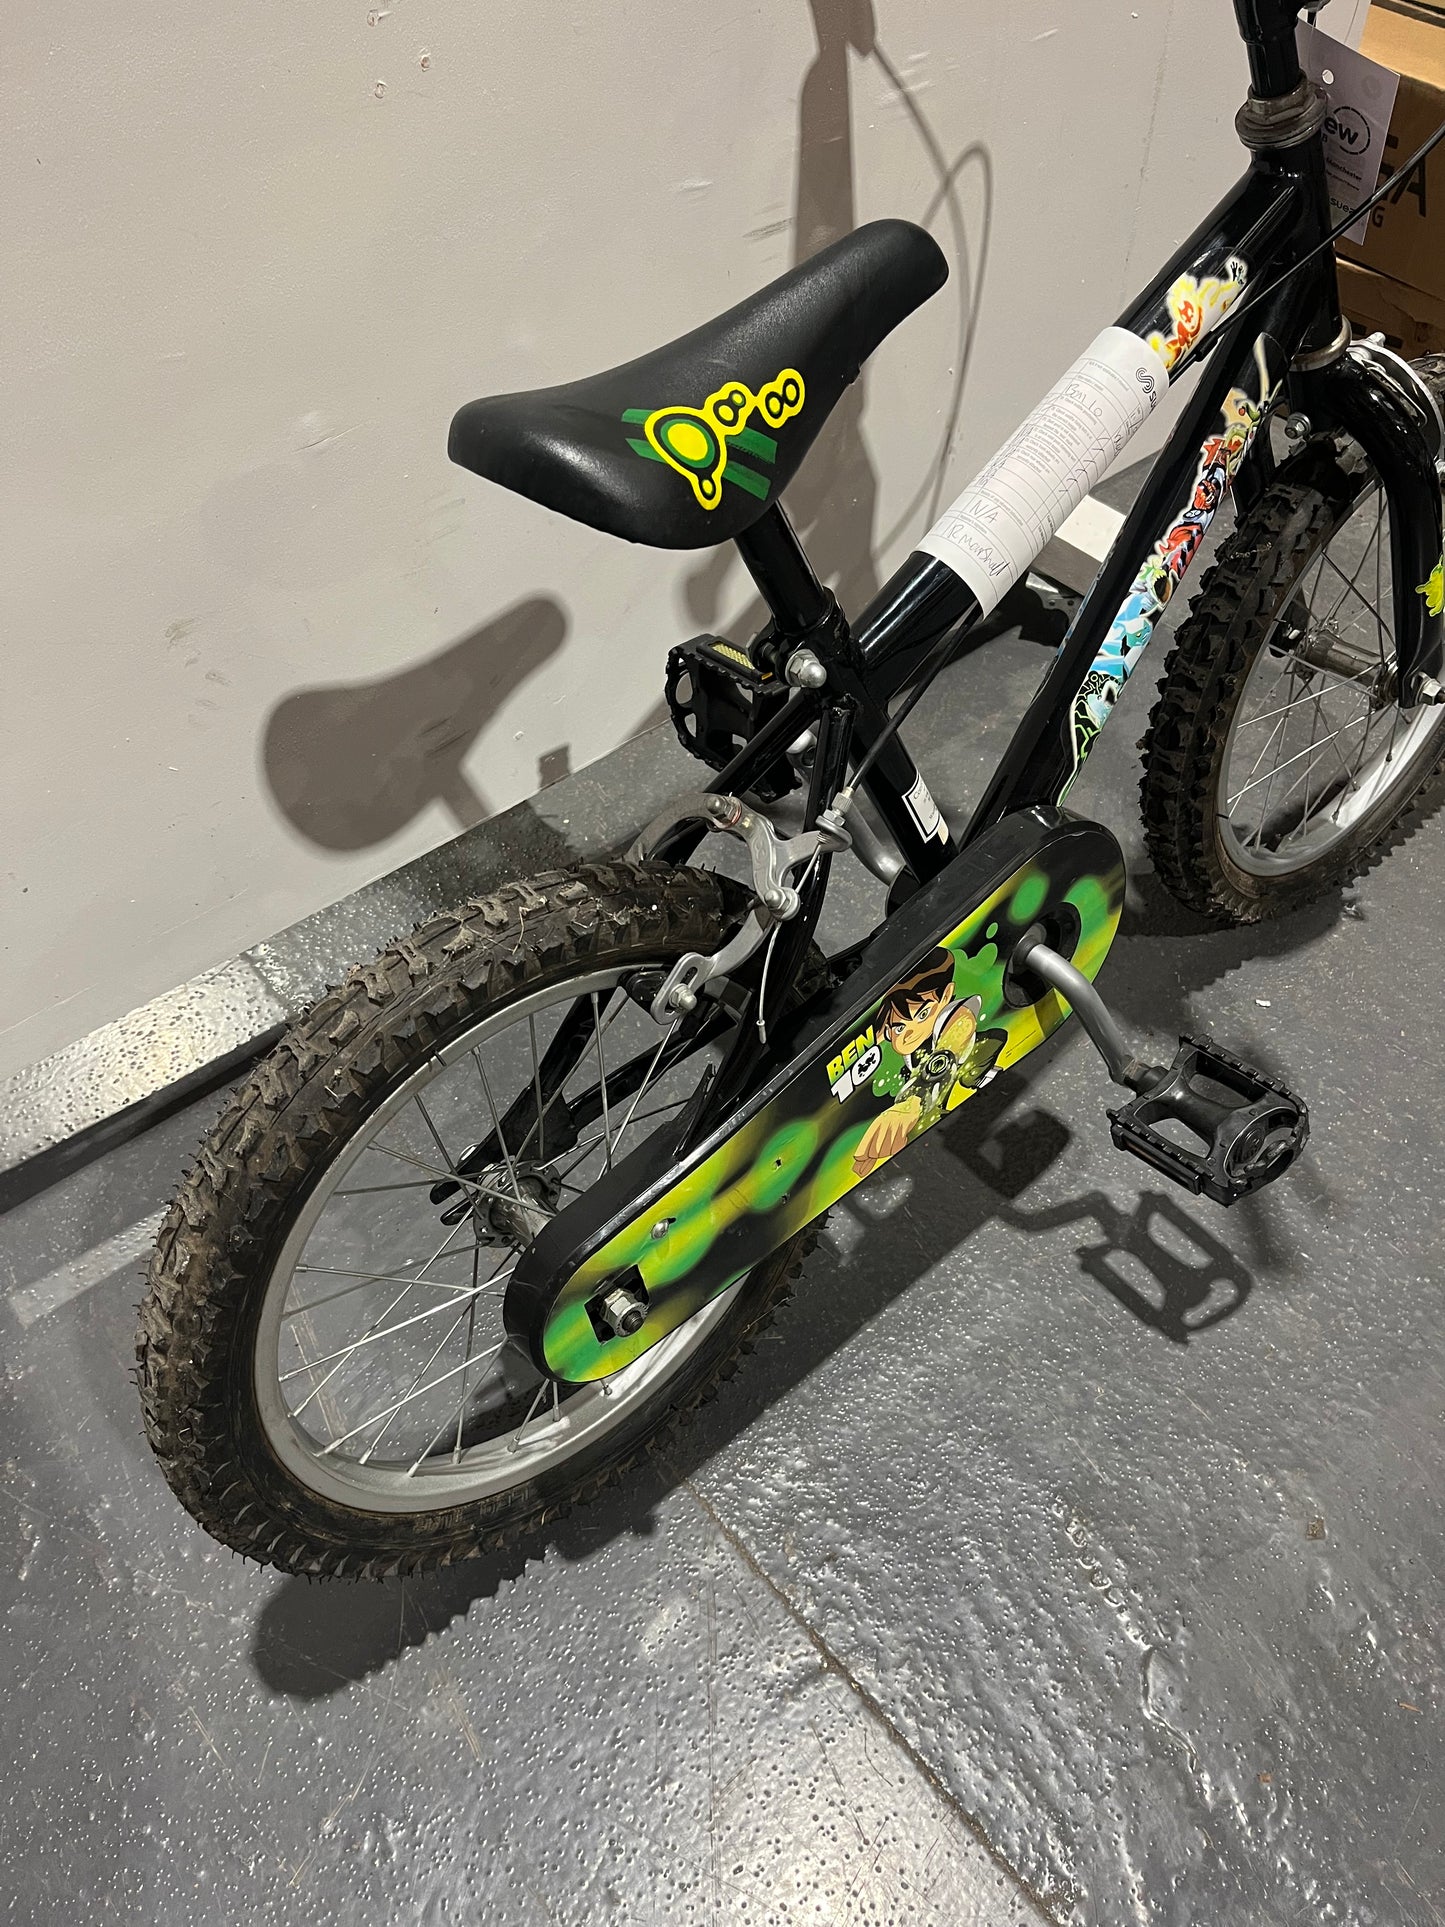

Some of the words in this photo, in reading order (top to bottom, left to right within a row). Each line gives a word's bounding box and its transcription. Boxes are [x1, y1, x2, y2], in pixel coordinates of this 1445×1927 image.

[969, 499, 1000, 524] N/A
[826, 1024, 875, 1086] BEN
[830, 1045, 882, 1104] 10
